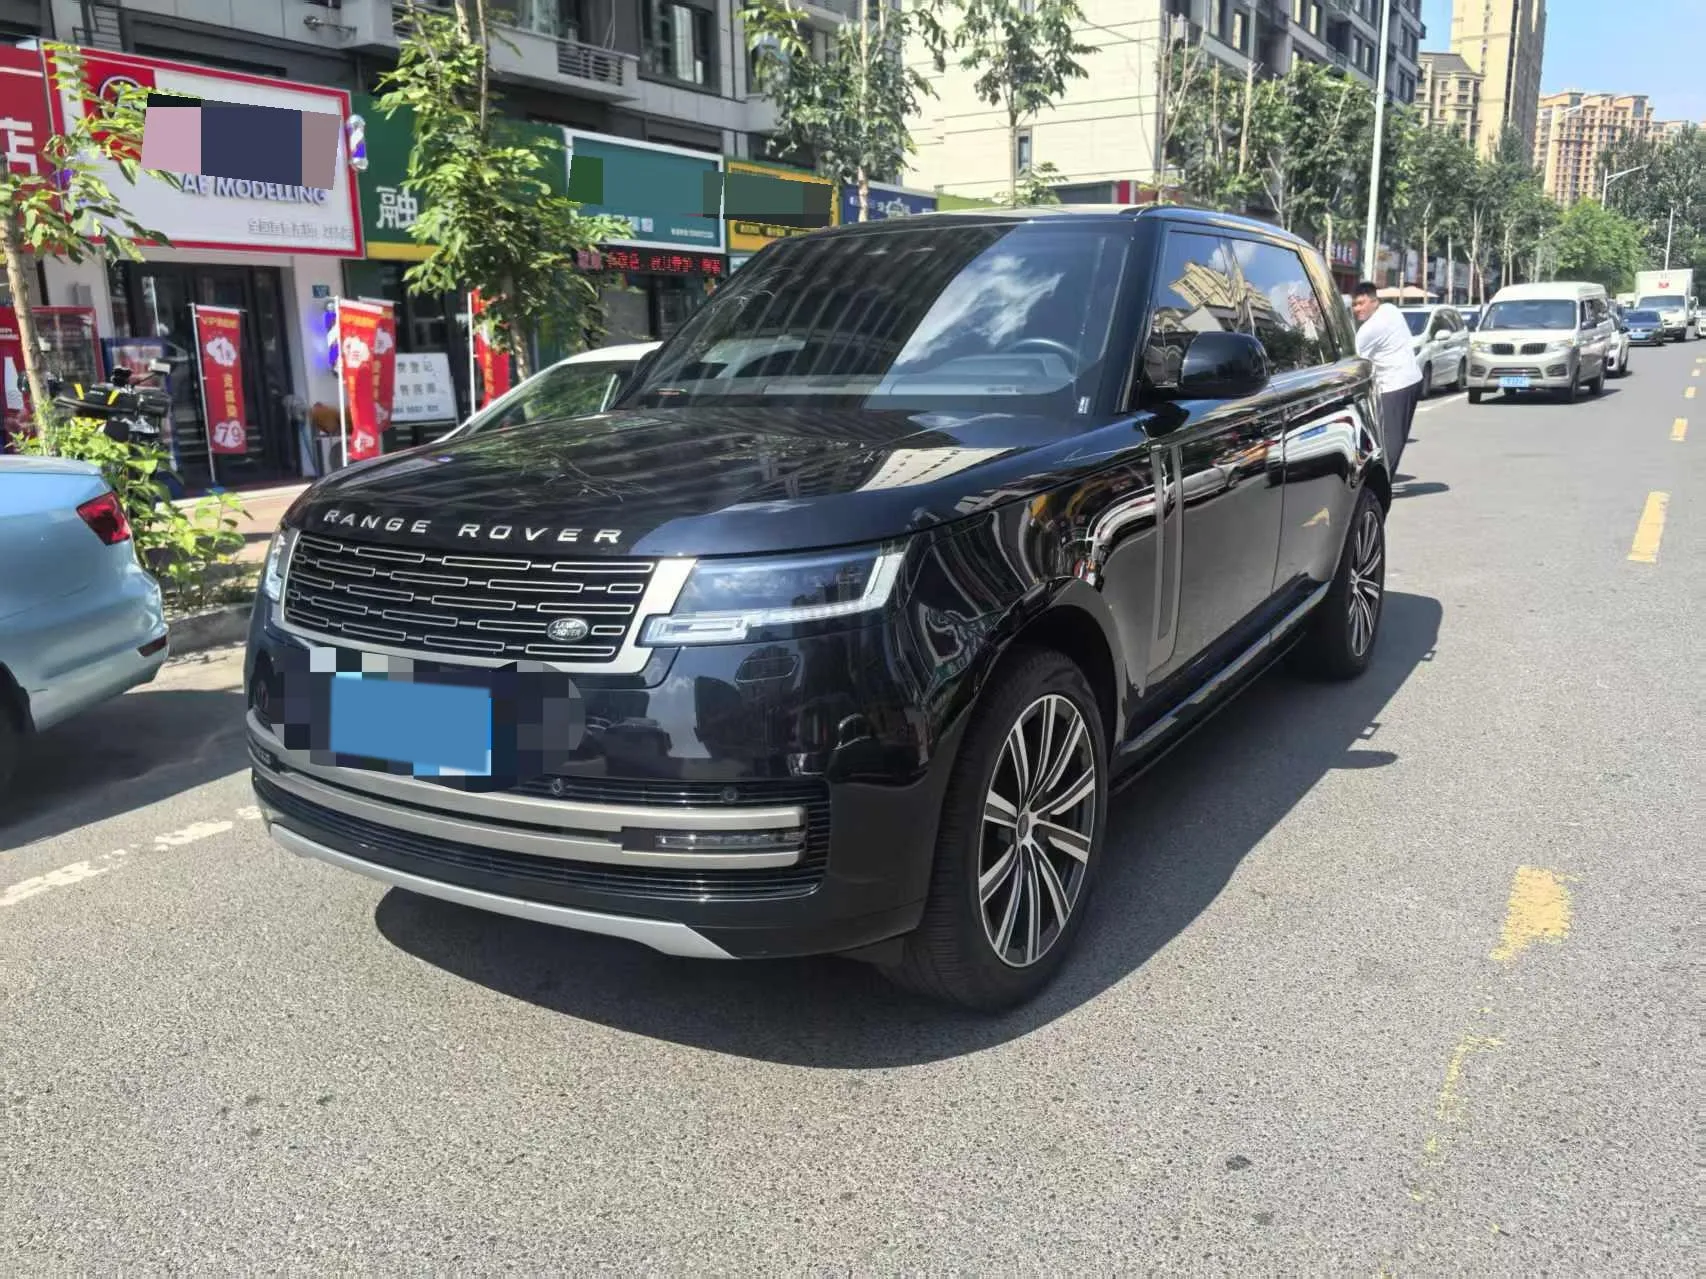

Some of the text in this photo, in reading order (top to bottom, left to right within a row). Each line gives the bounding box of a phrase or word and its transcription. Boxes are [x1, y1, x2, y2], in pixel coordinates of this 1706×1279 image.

[215, 176, 329, 204] MODELLING
[323, 509, 623, 544] RANGE ROVER
